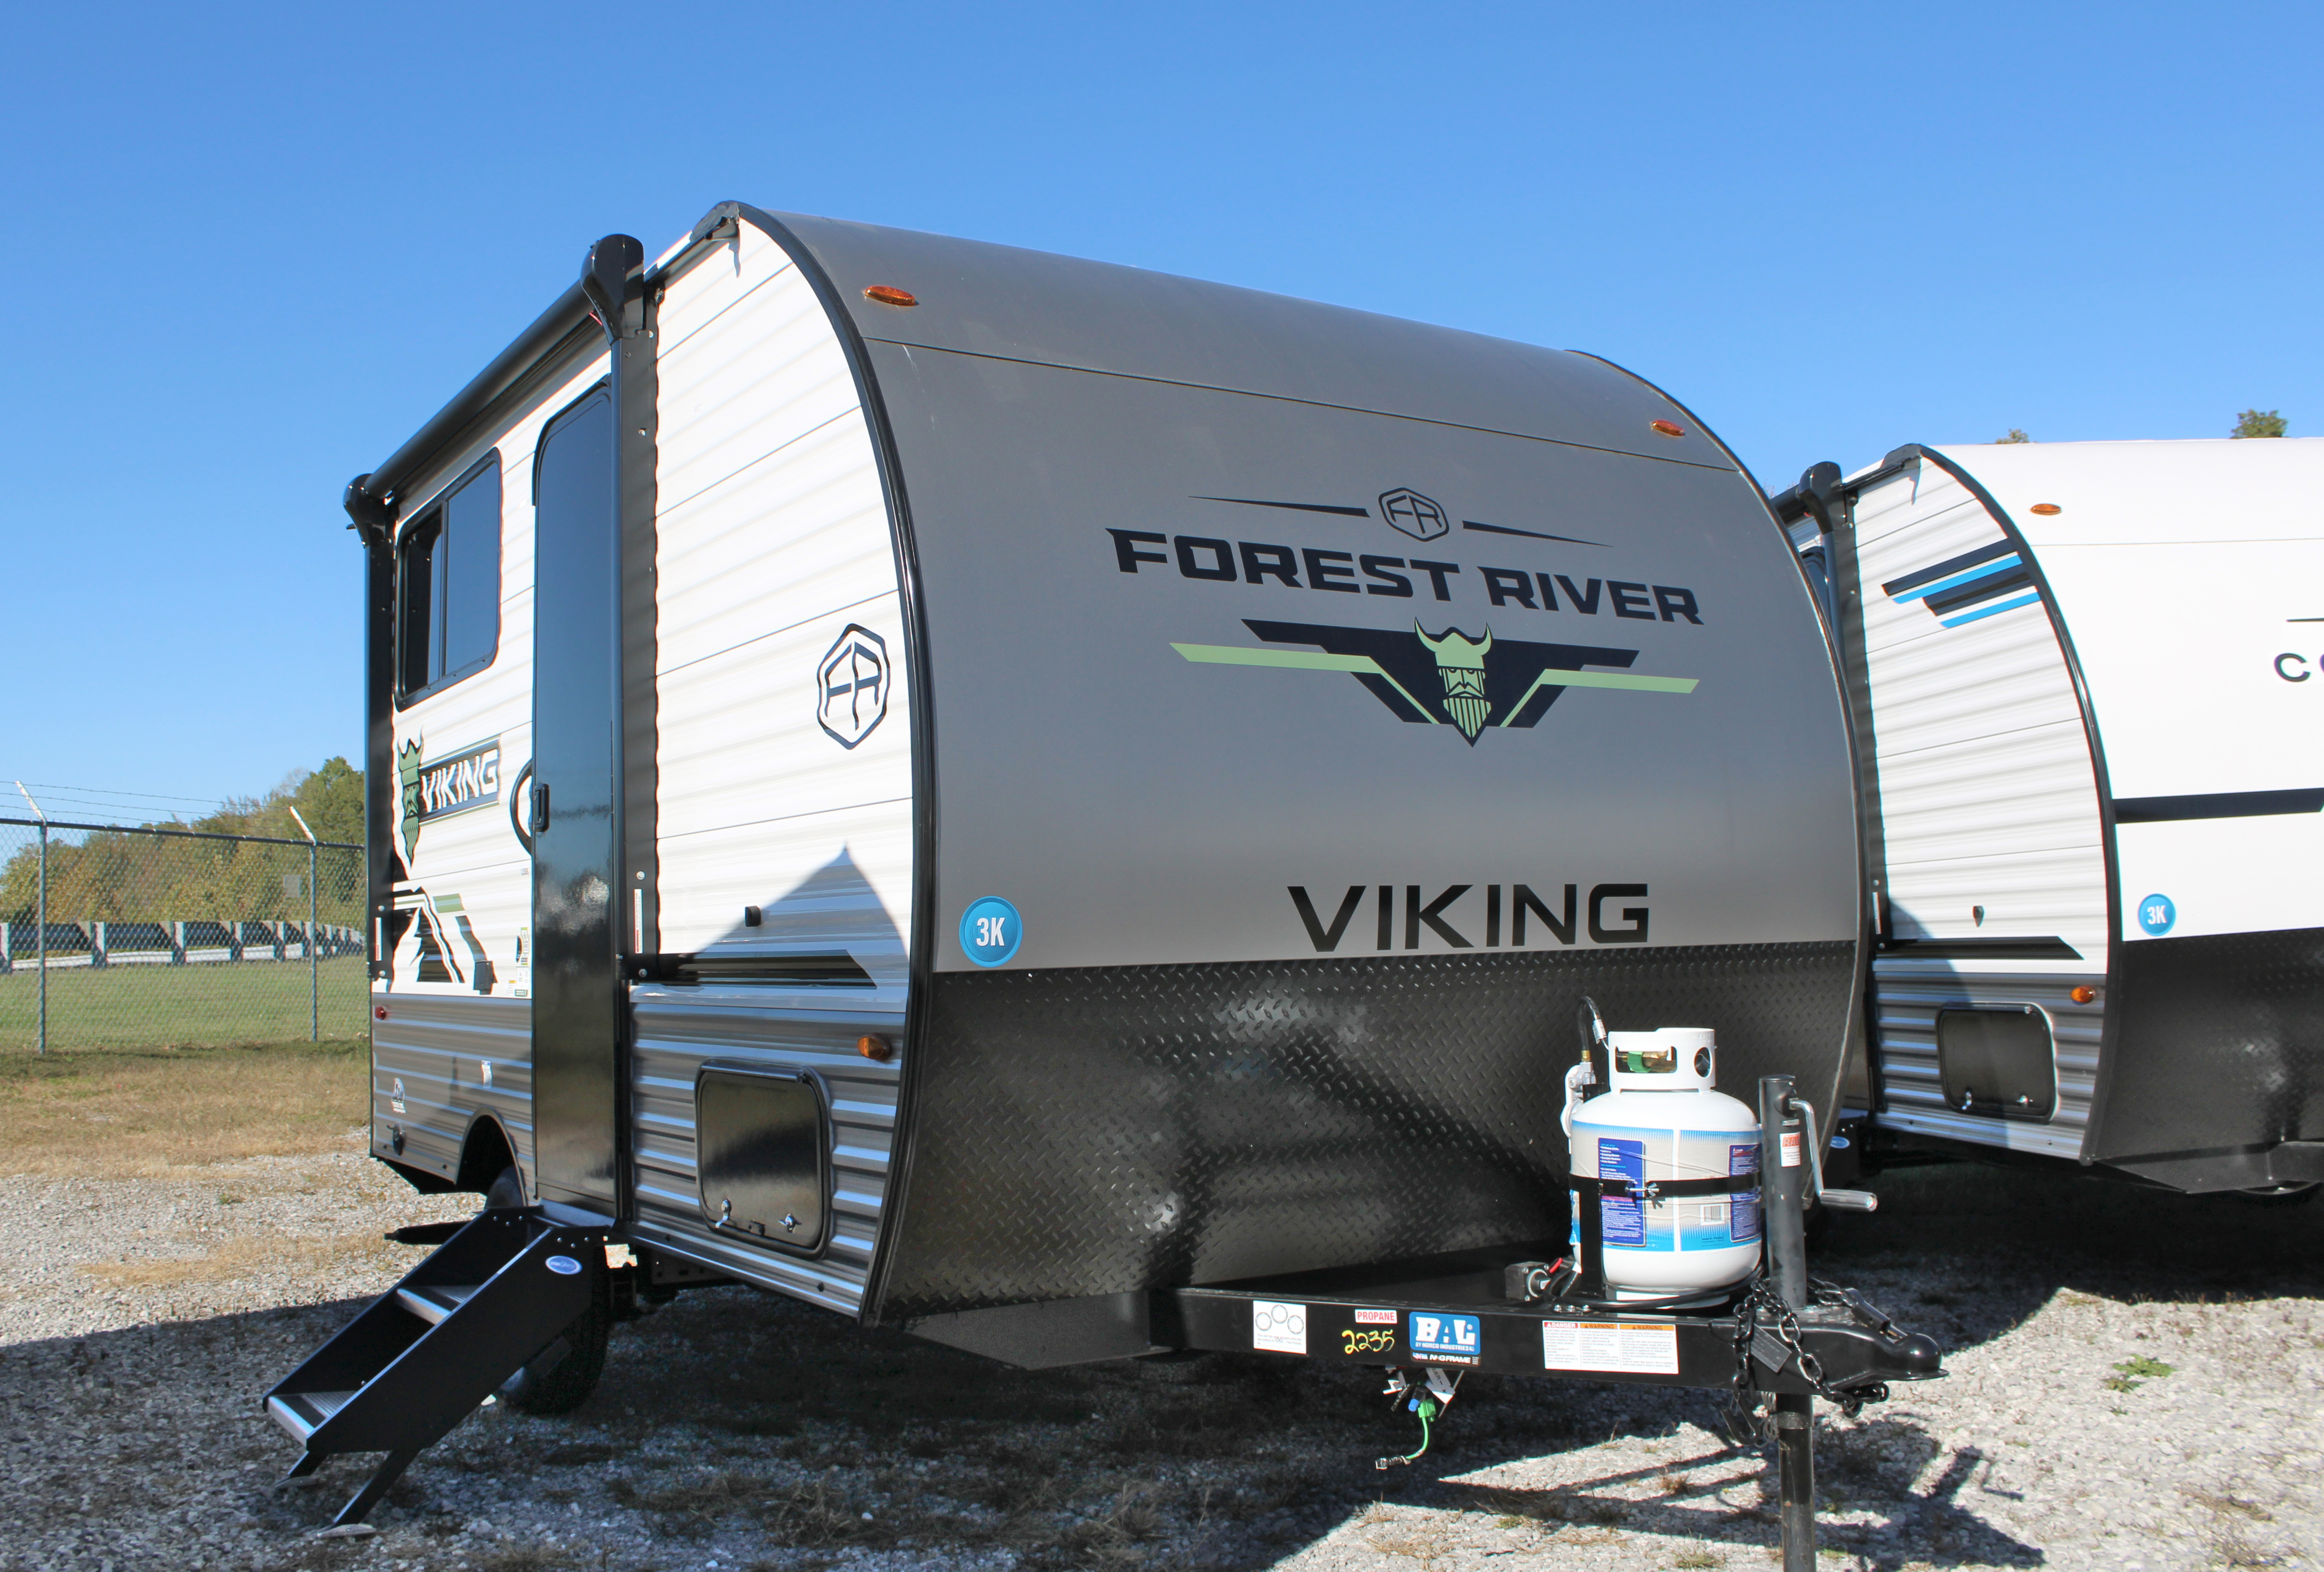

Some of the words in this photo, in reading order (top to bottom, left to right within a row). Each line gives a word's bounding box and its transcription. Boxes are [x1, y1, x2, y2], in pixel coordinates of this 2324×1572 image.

[1105, 528, 1460, 602] FOREST
[1477, 566, 1704, 625] RIVER
[421, 748, 499, 813] VIKING
[1287, 884, 1649, 952] VIKING
[2147, 906, 2167, 925] 3K
[976, 917, 1006, 947] 3K
[1357, 1312, 1395, 1321] PROPANE
[1342, 1329, 1395, 1355] 2235
[1440, 1343, 1469, 1352] INDUSTRIES
[1446, 1355, 1471, 1364] FRAME
